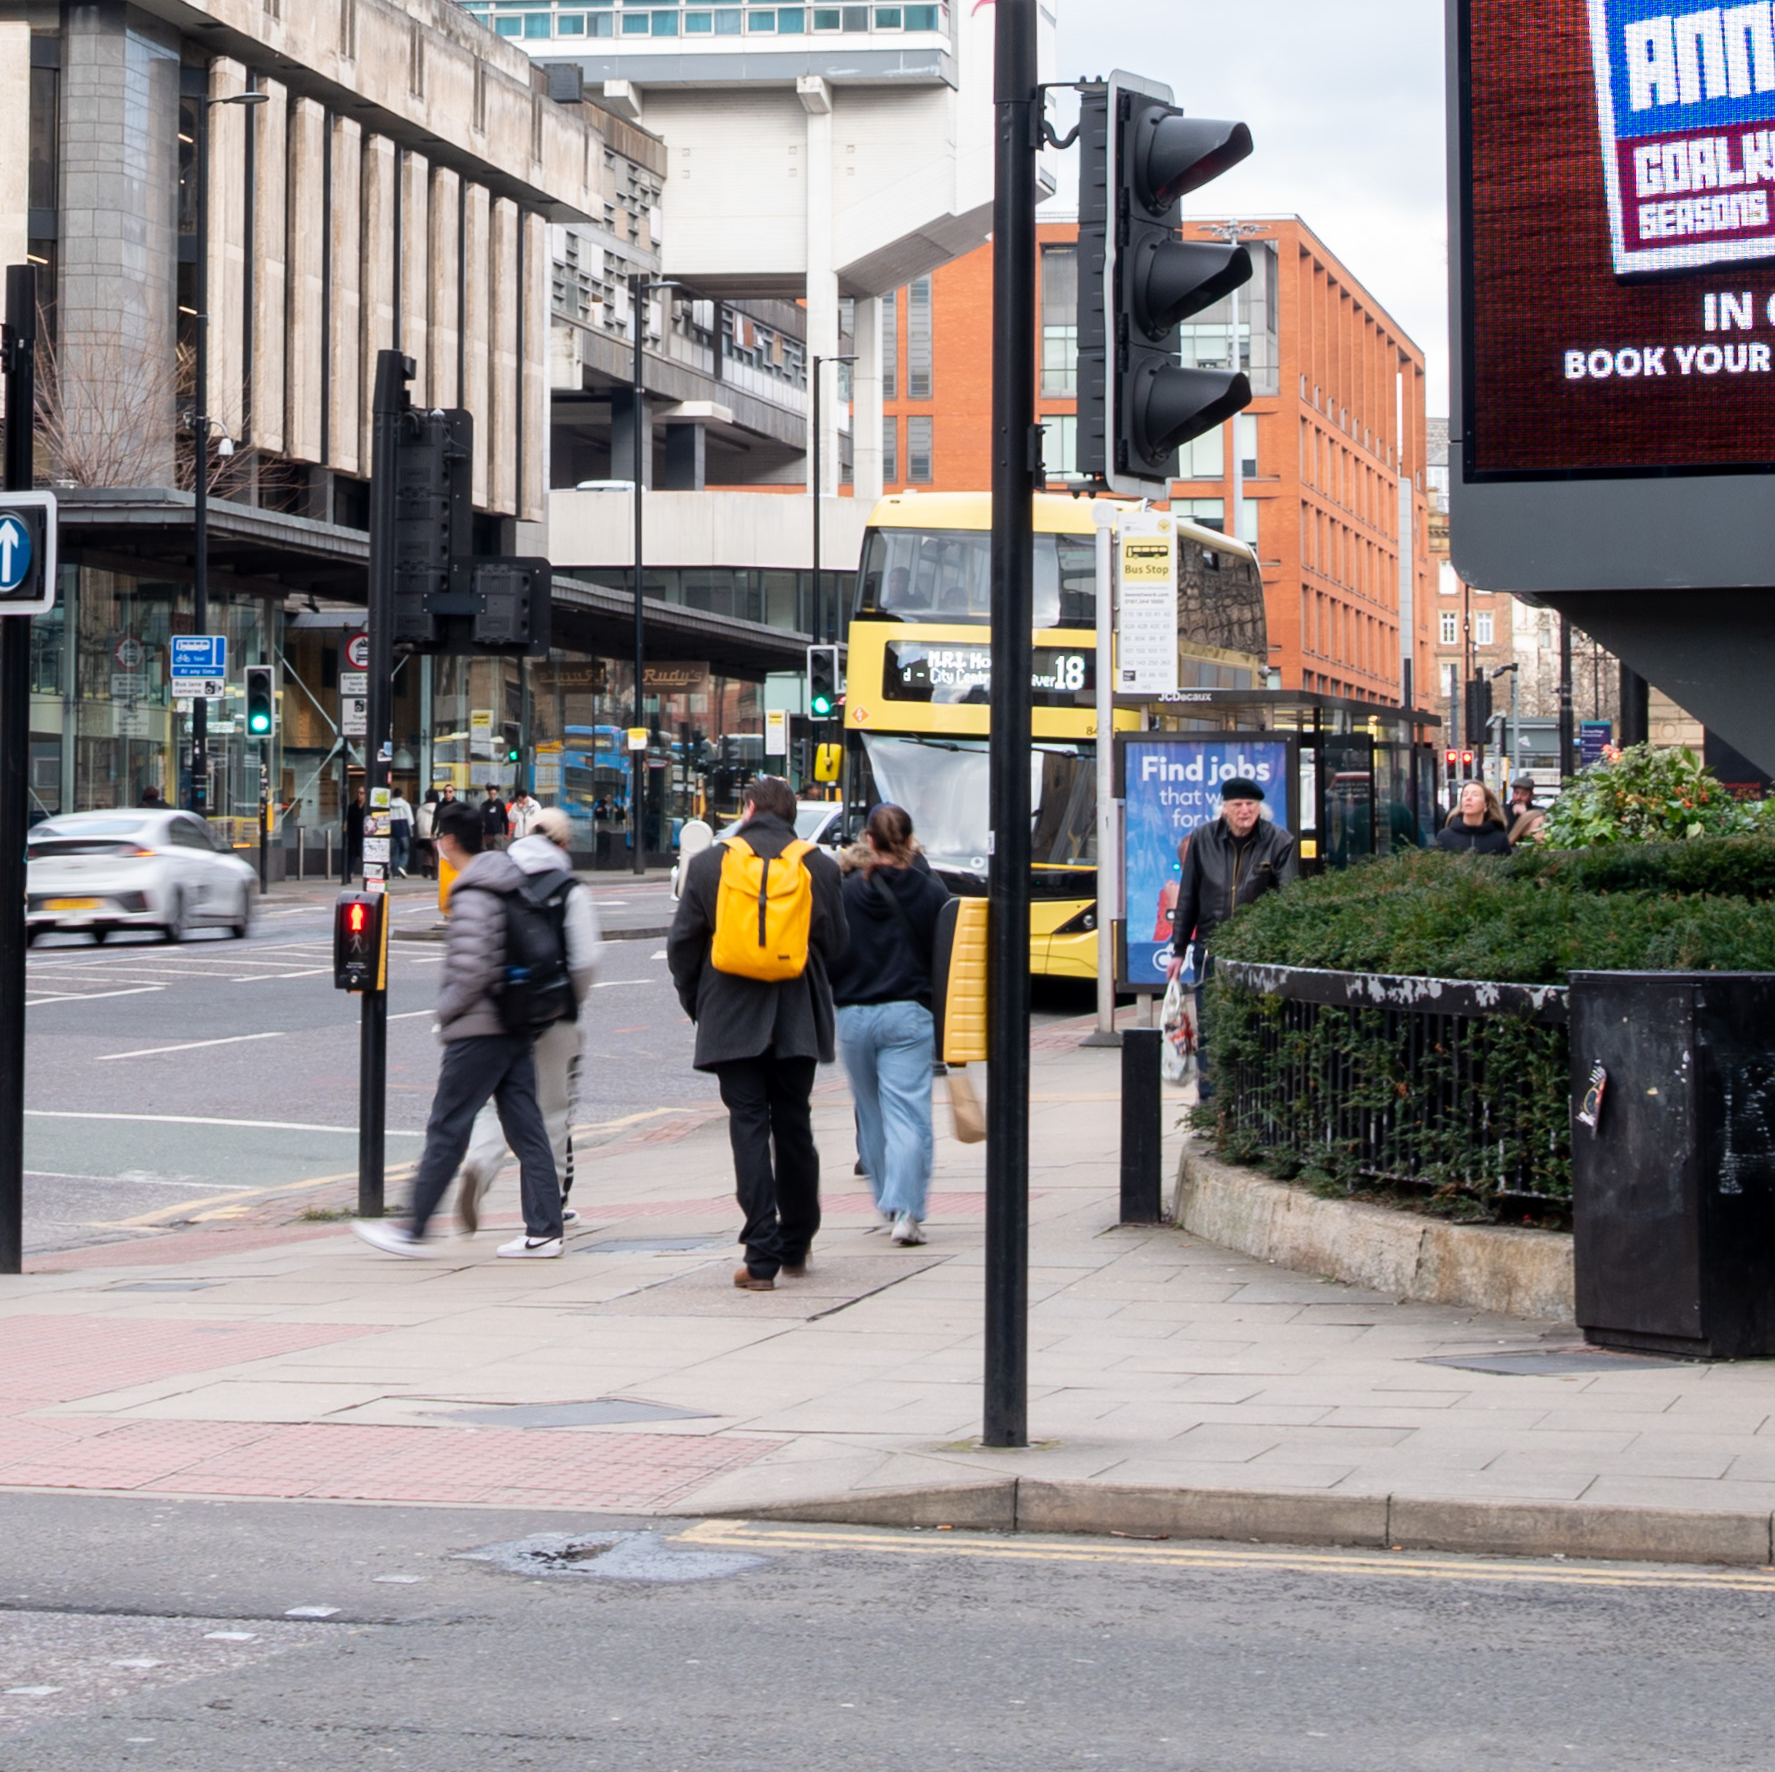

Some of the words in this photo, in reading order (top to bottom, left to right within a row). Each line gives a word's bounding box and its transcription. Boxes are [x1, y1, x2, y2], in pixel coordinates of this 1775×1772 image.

[1638, 190, 1770, 240] SEASONS
[1702, 290, 1753, 332] IN
[1564, 345, 1667, 381] BOOK
[1673, 341, 1771, 377] YOUR
[1125, 565, 1144, 575] Bus
[1145, 565, 1169, 576] Stop
[969, 652, 991, 670] Ho
[643, 668, 702, 685] Rudy's
[930, 669, 954, 685] City
[956, 669, 991, 685] Centr
[1055, 655, 1085, 690] 18
[1158, 692, 1212, 703] JCDecaux
[1141, 755, 1203, 781] Find
[1208, 755, 1271, 785] jobs
[1160, 786, 1202, 805] that
[1171, 809, 1203, 828] for
